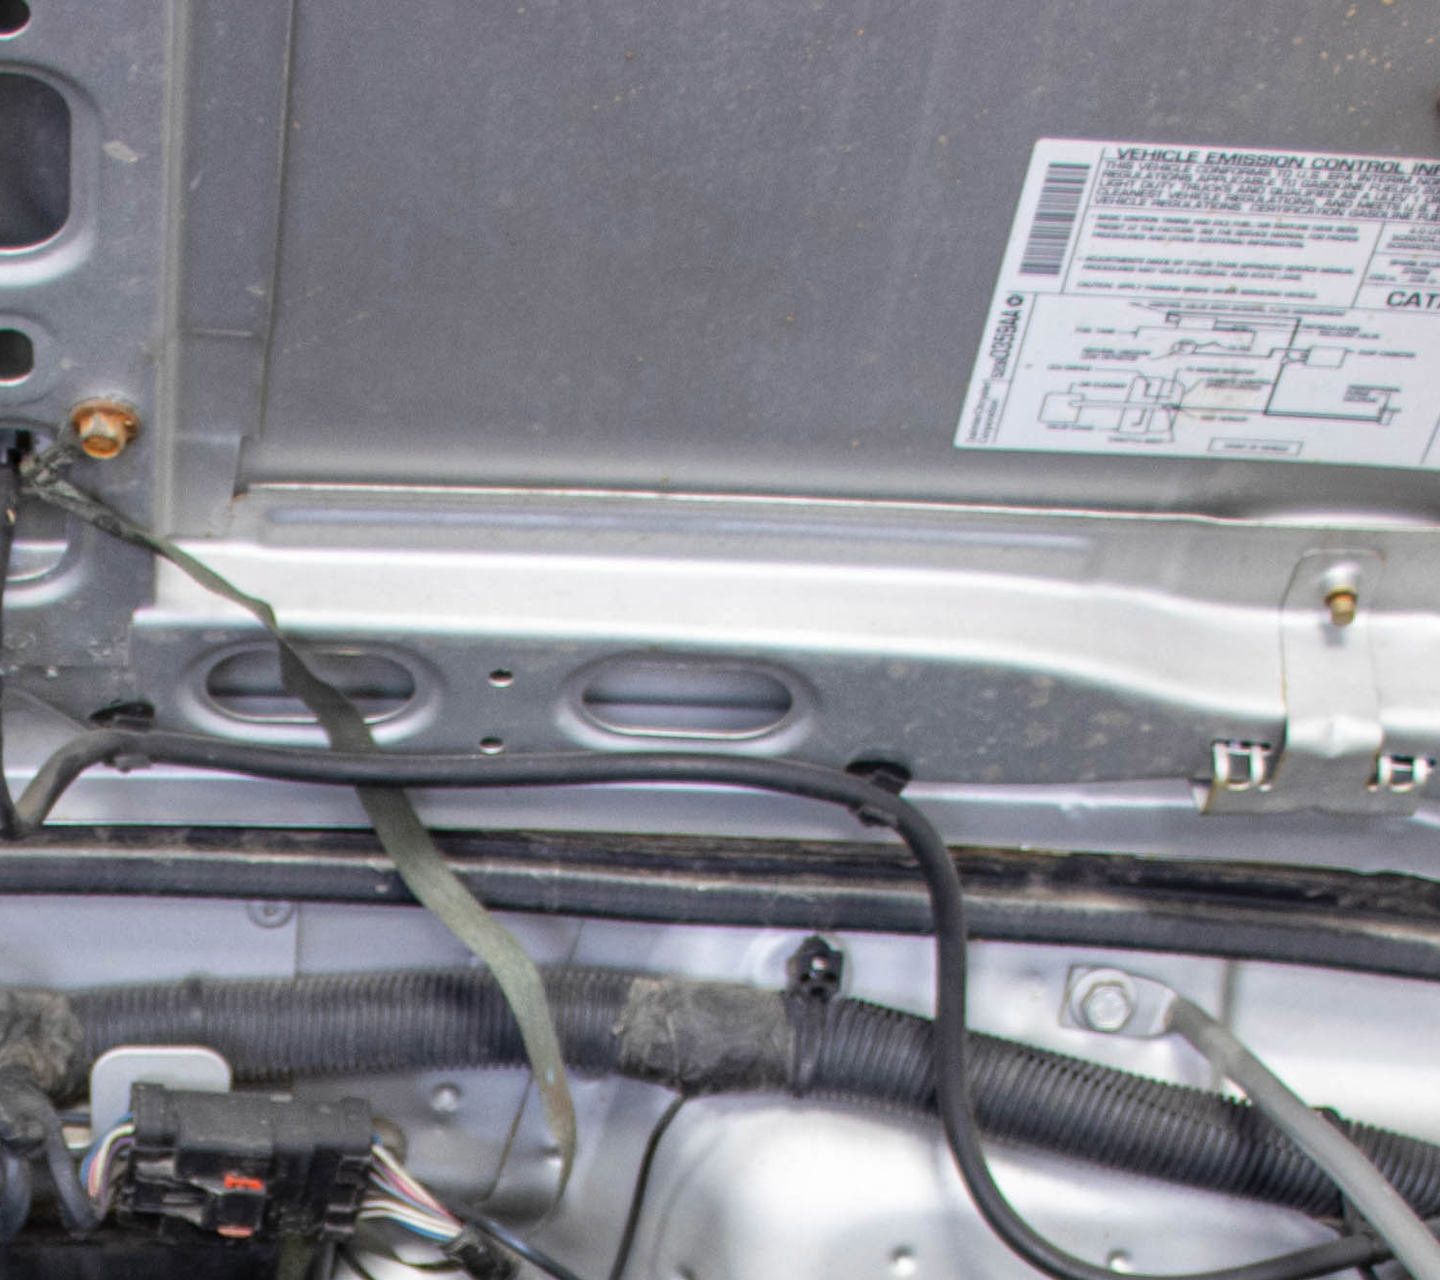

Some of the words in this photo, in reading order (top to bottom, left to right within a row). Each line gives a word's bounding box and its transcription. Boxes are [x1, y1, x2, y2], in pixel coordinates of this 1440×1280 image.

[1118, 148, 1199, 164] VEHICLE
[1206, 152, 1304, 169] EMISSION
[1311, 157, 1403, 175] CONTROL
